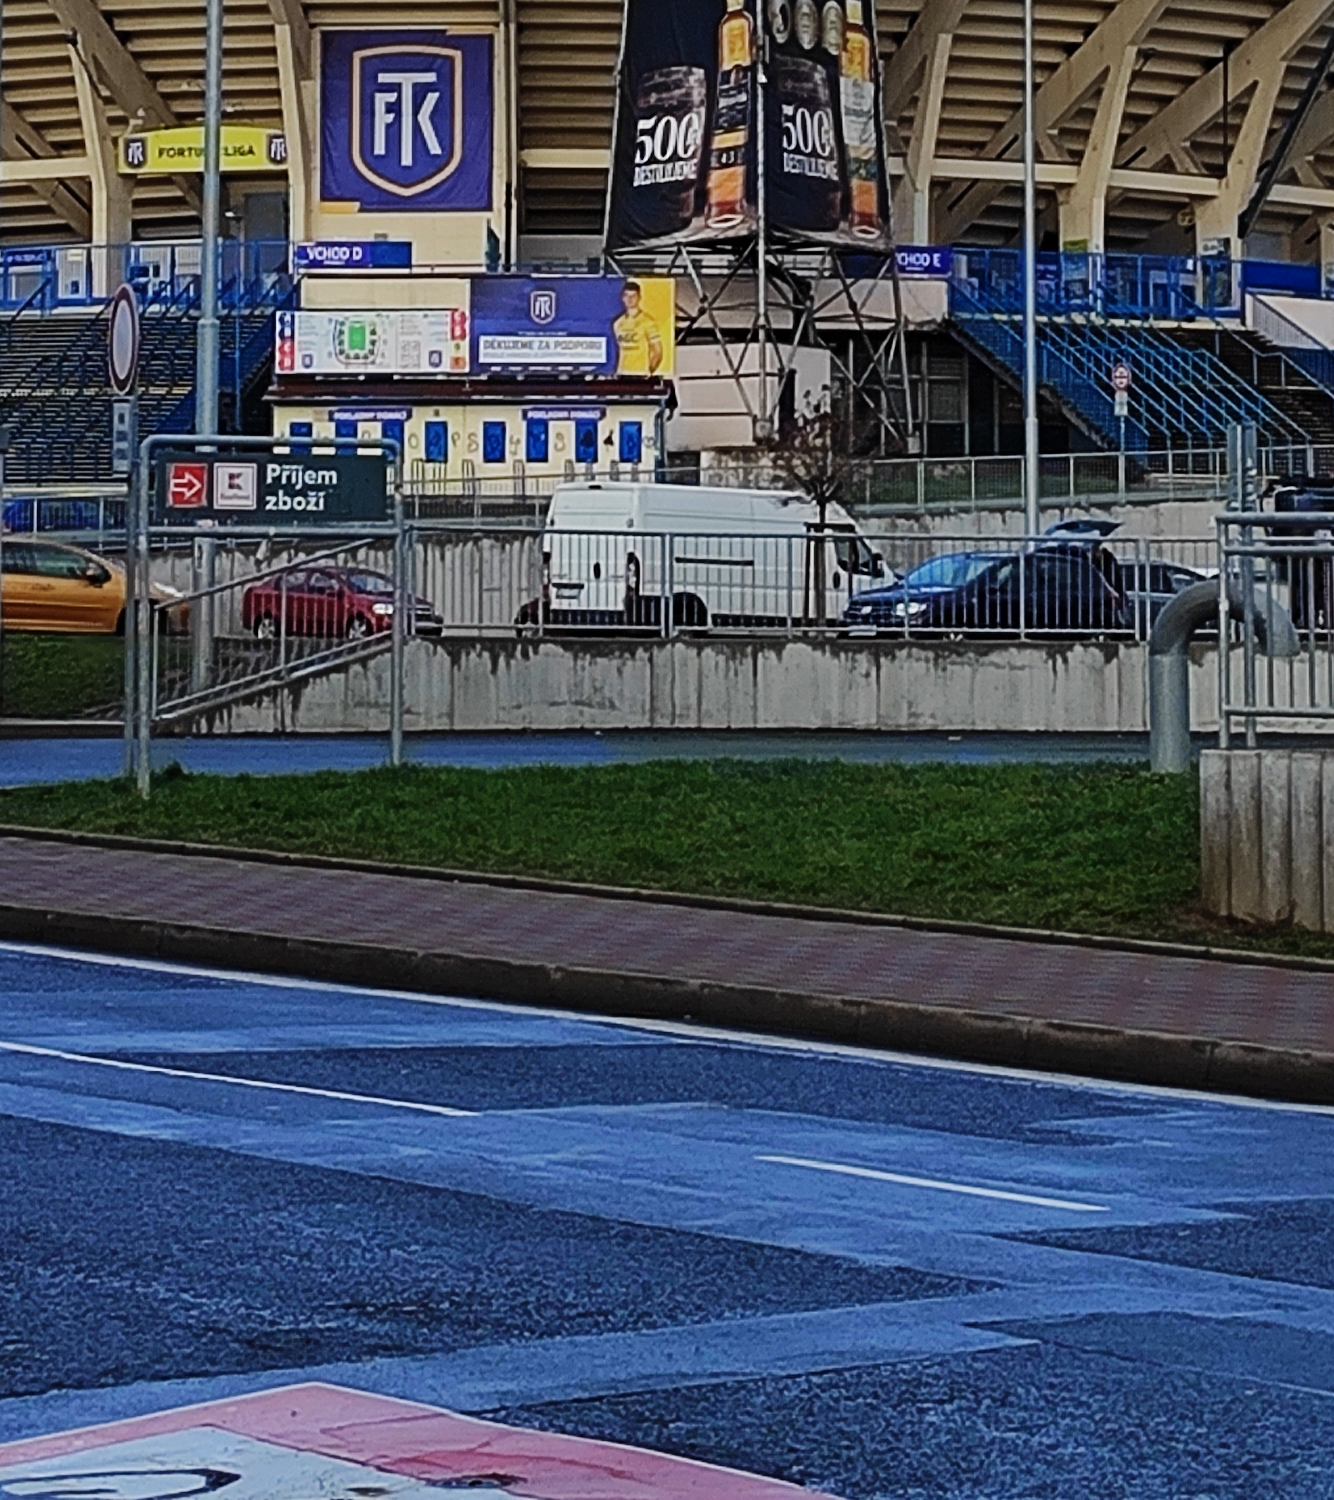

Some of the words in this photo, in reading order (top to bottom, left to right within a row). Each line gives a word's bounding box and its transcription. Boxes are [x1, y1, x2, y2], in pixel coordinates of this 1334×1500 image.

[352, 246, 363, 261] D
[266, 463, 338, 490] Příjem
[265, 490, 326, 512] zboží
